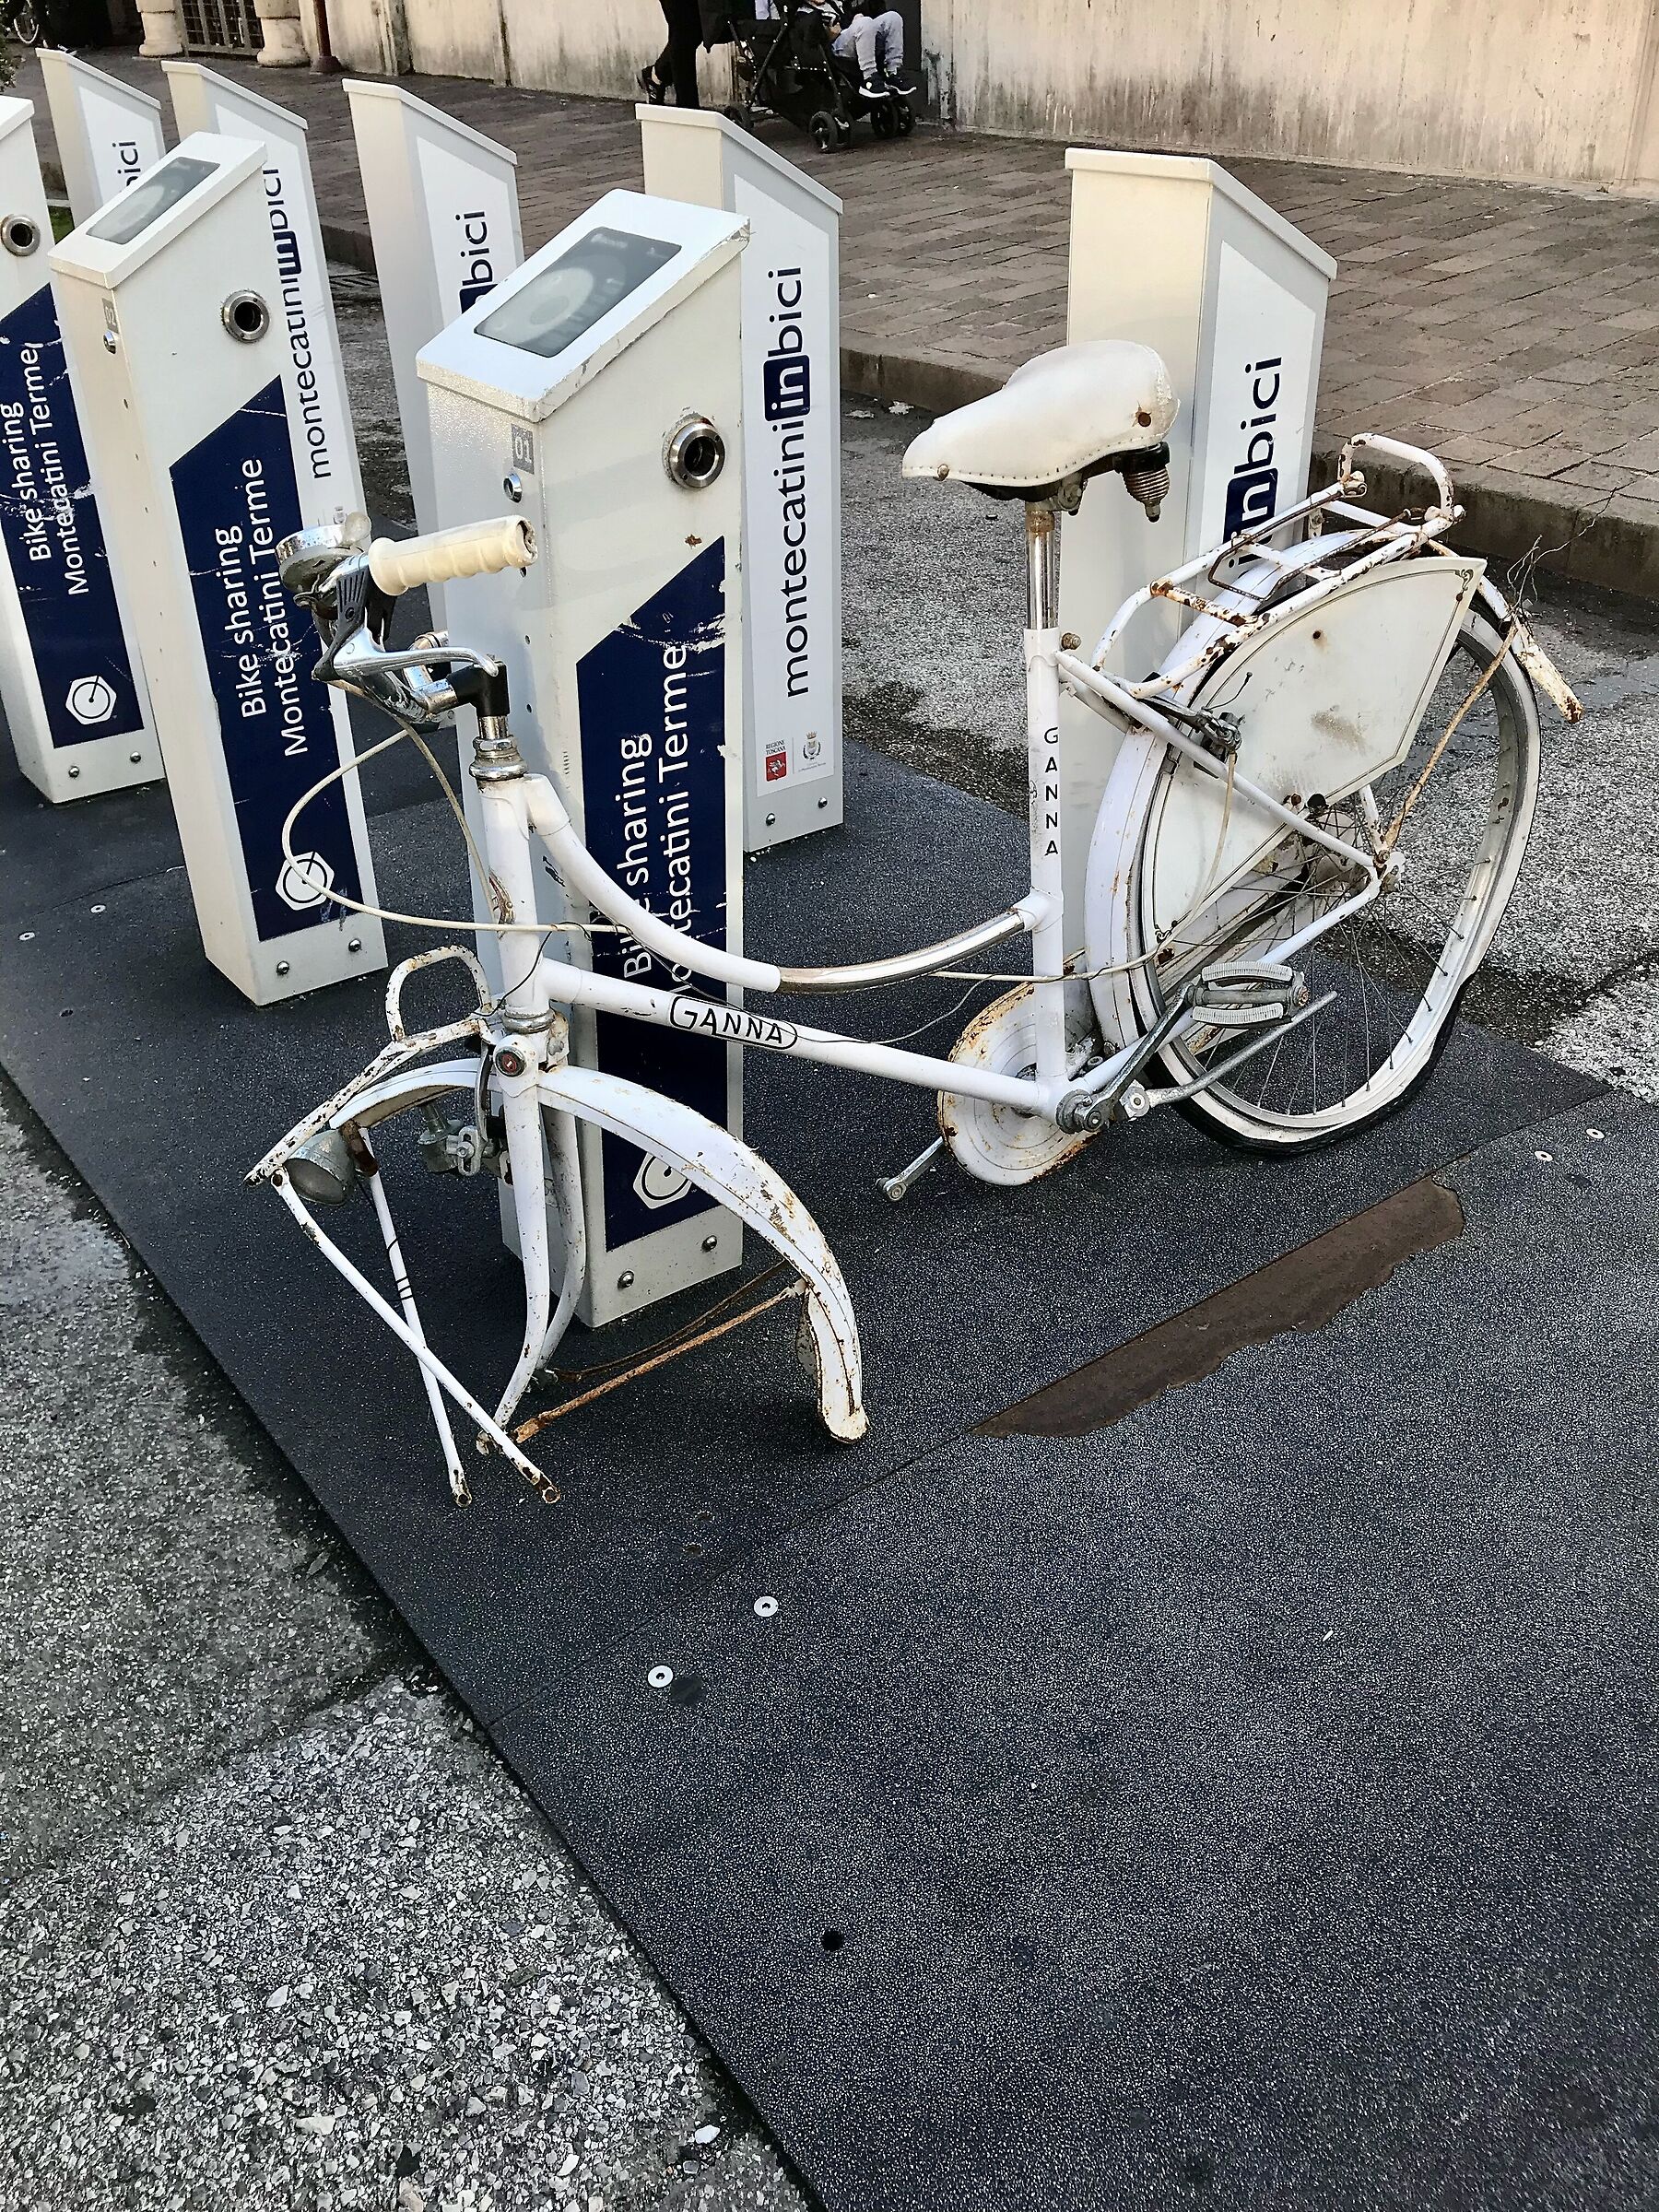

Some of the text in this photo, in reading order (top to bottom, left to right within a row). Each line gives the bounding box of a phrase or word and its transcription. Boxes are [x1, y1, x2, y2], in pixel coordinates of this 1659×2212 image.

[105, 306, 117, 326] 02
[455, 211, 494, 302] bici
[0, 401, 52, 560] Bike sharing
[21, 347, 89, 594] Montecatini Terme
[515, 436, 532, 463] 01
[215, 525, 266, 717] Bike sharing
[241, 458, 308, 757] Montecatini Terme
[658, 645, 689, 776] Terme
[618, 734, 653, 886] sharing
[1043, 726, 1059, 857] GANNA
[670, 995, 783, 1049] GANNA
